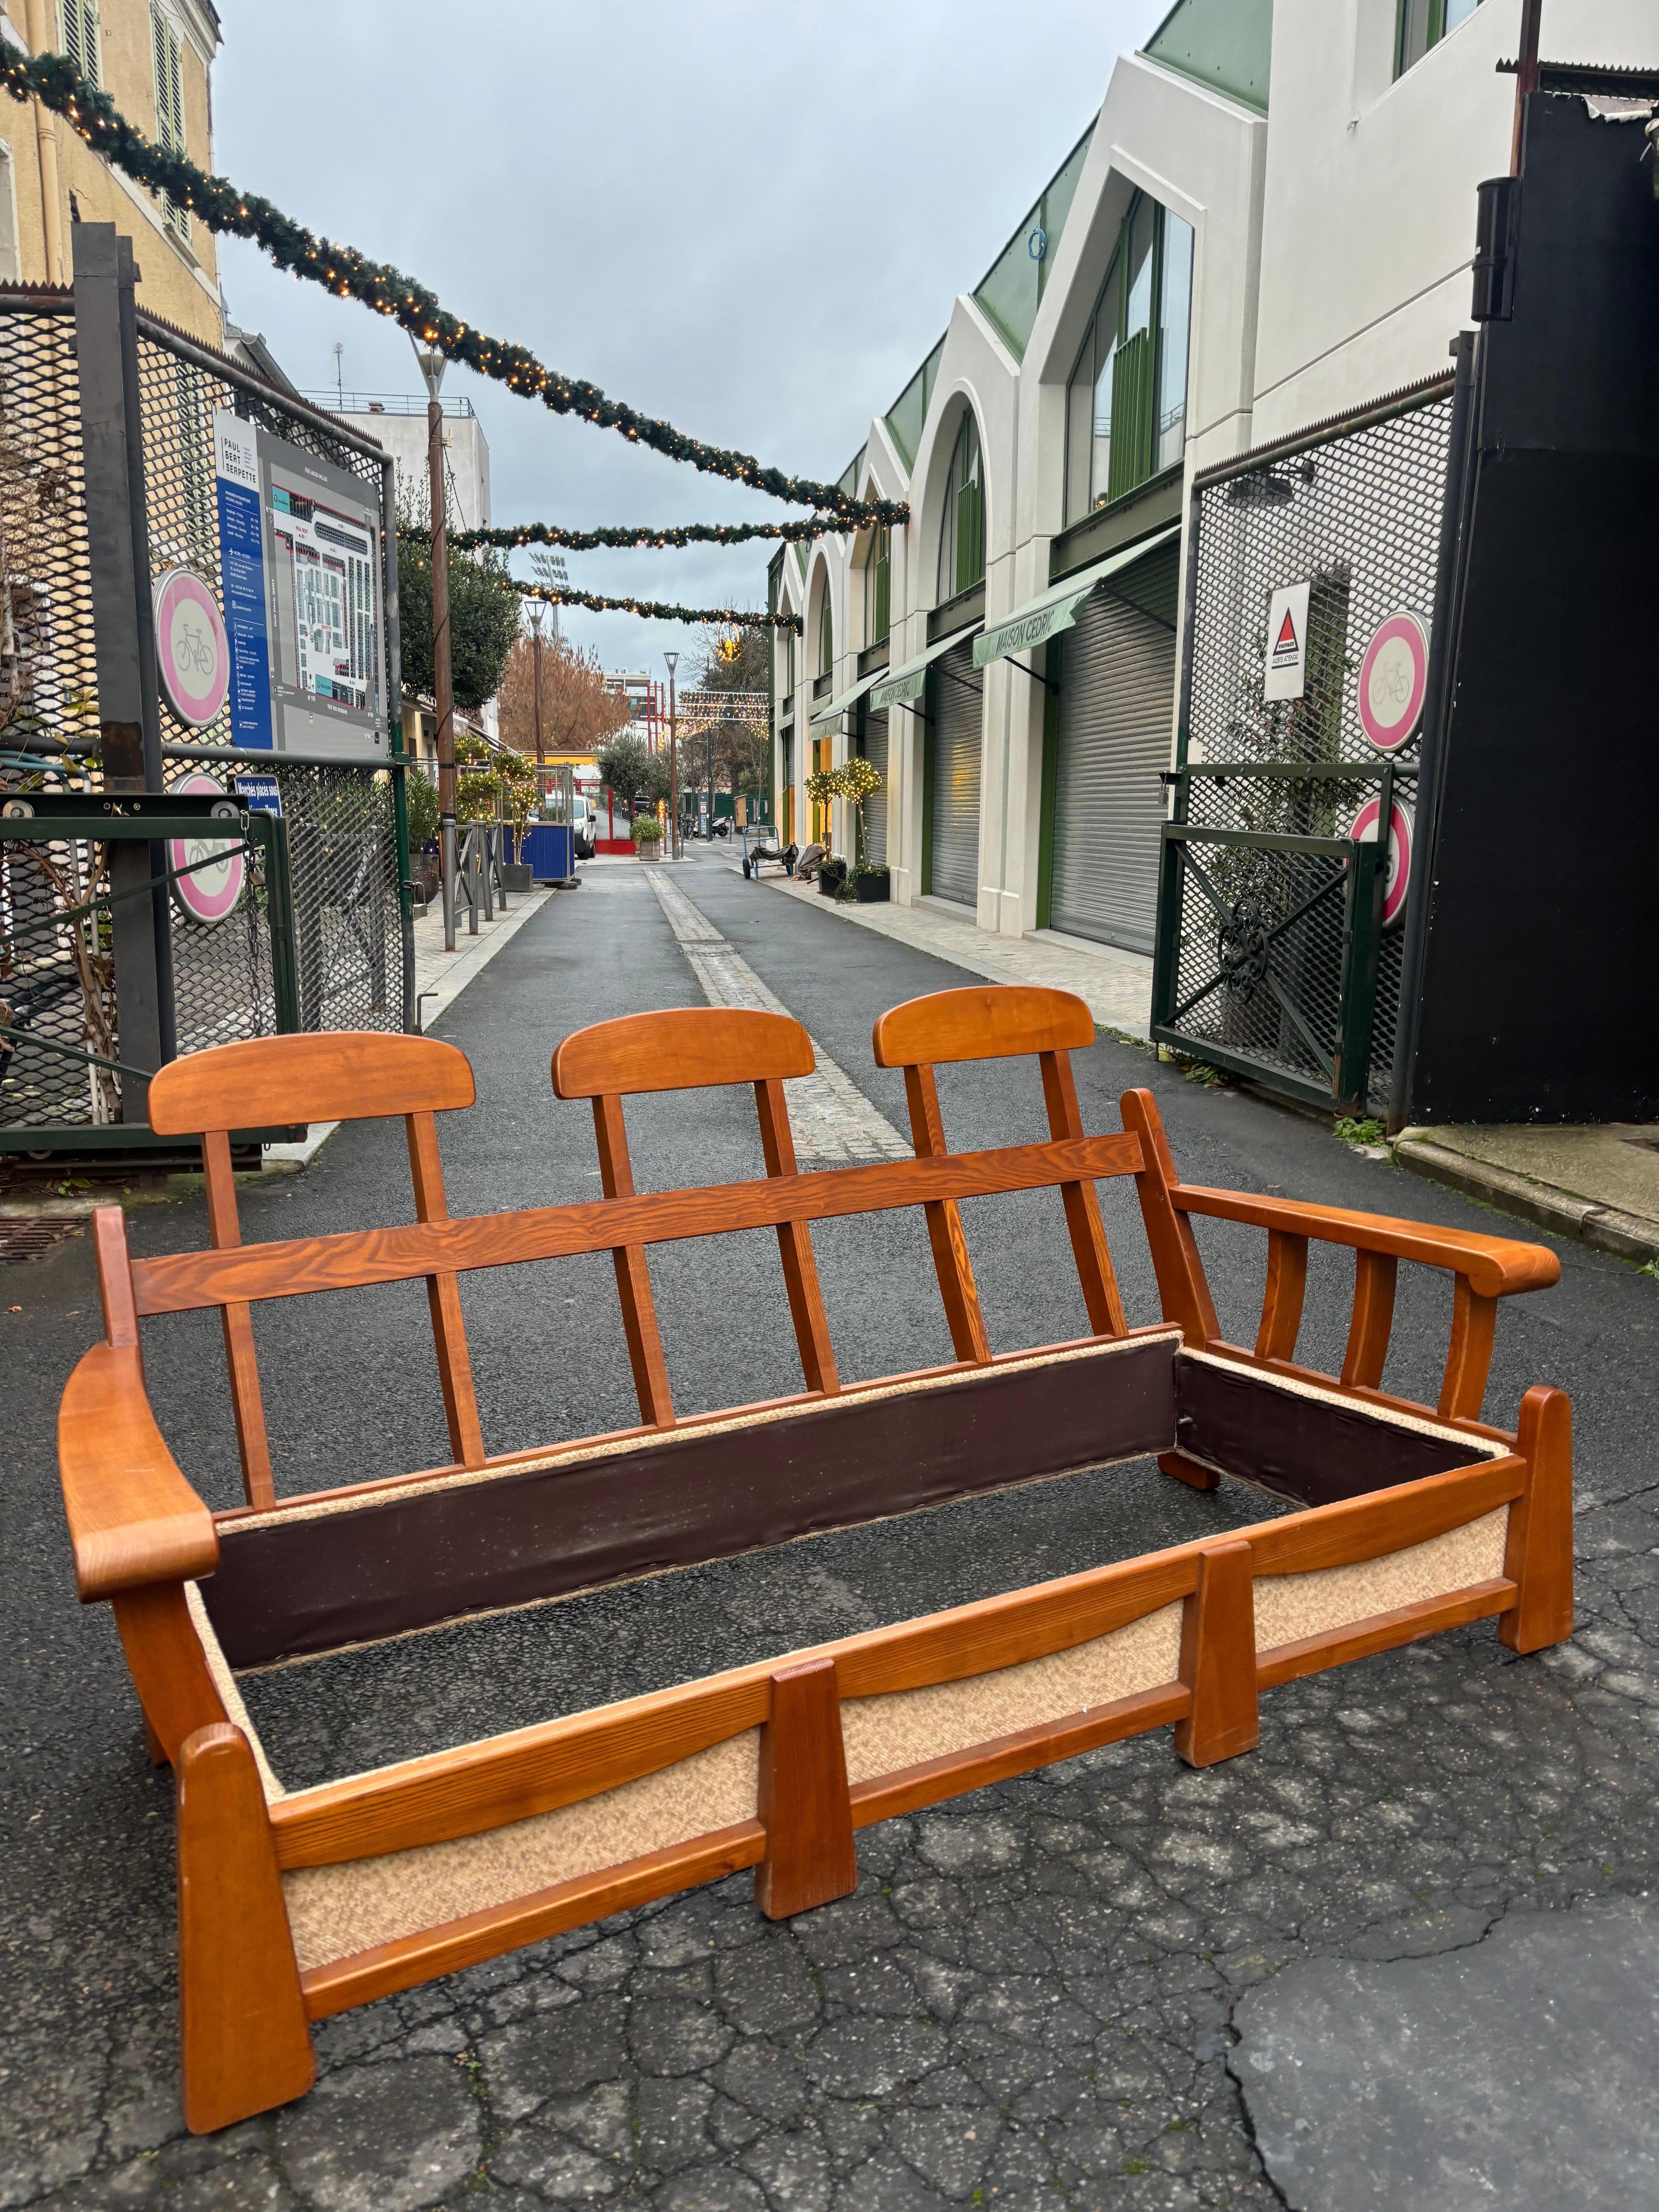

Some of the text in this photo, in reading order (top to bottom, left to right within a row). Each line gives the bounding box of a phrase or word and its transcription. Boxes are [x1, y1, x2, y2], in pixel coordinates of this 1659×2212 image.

[224, 438, 240, 452] PAUL
[225, 451, 240, 464] BERT
[226, 463, 256, 483] SERPETTE
[996, 623, 1026, 654] MAISON
[238, 782, 256, 797] Marchés
[256, 782, 269, 800] placés
